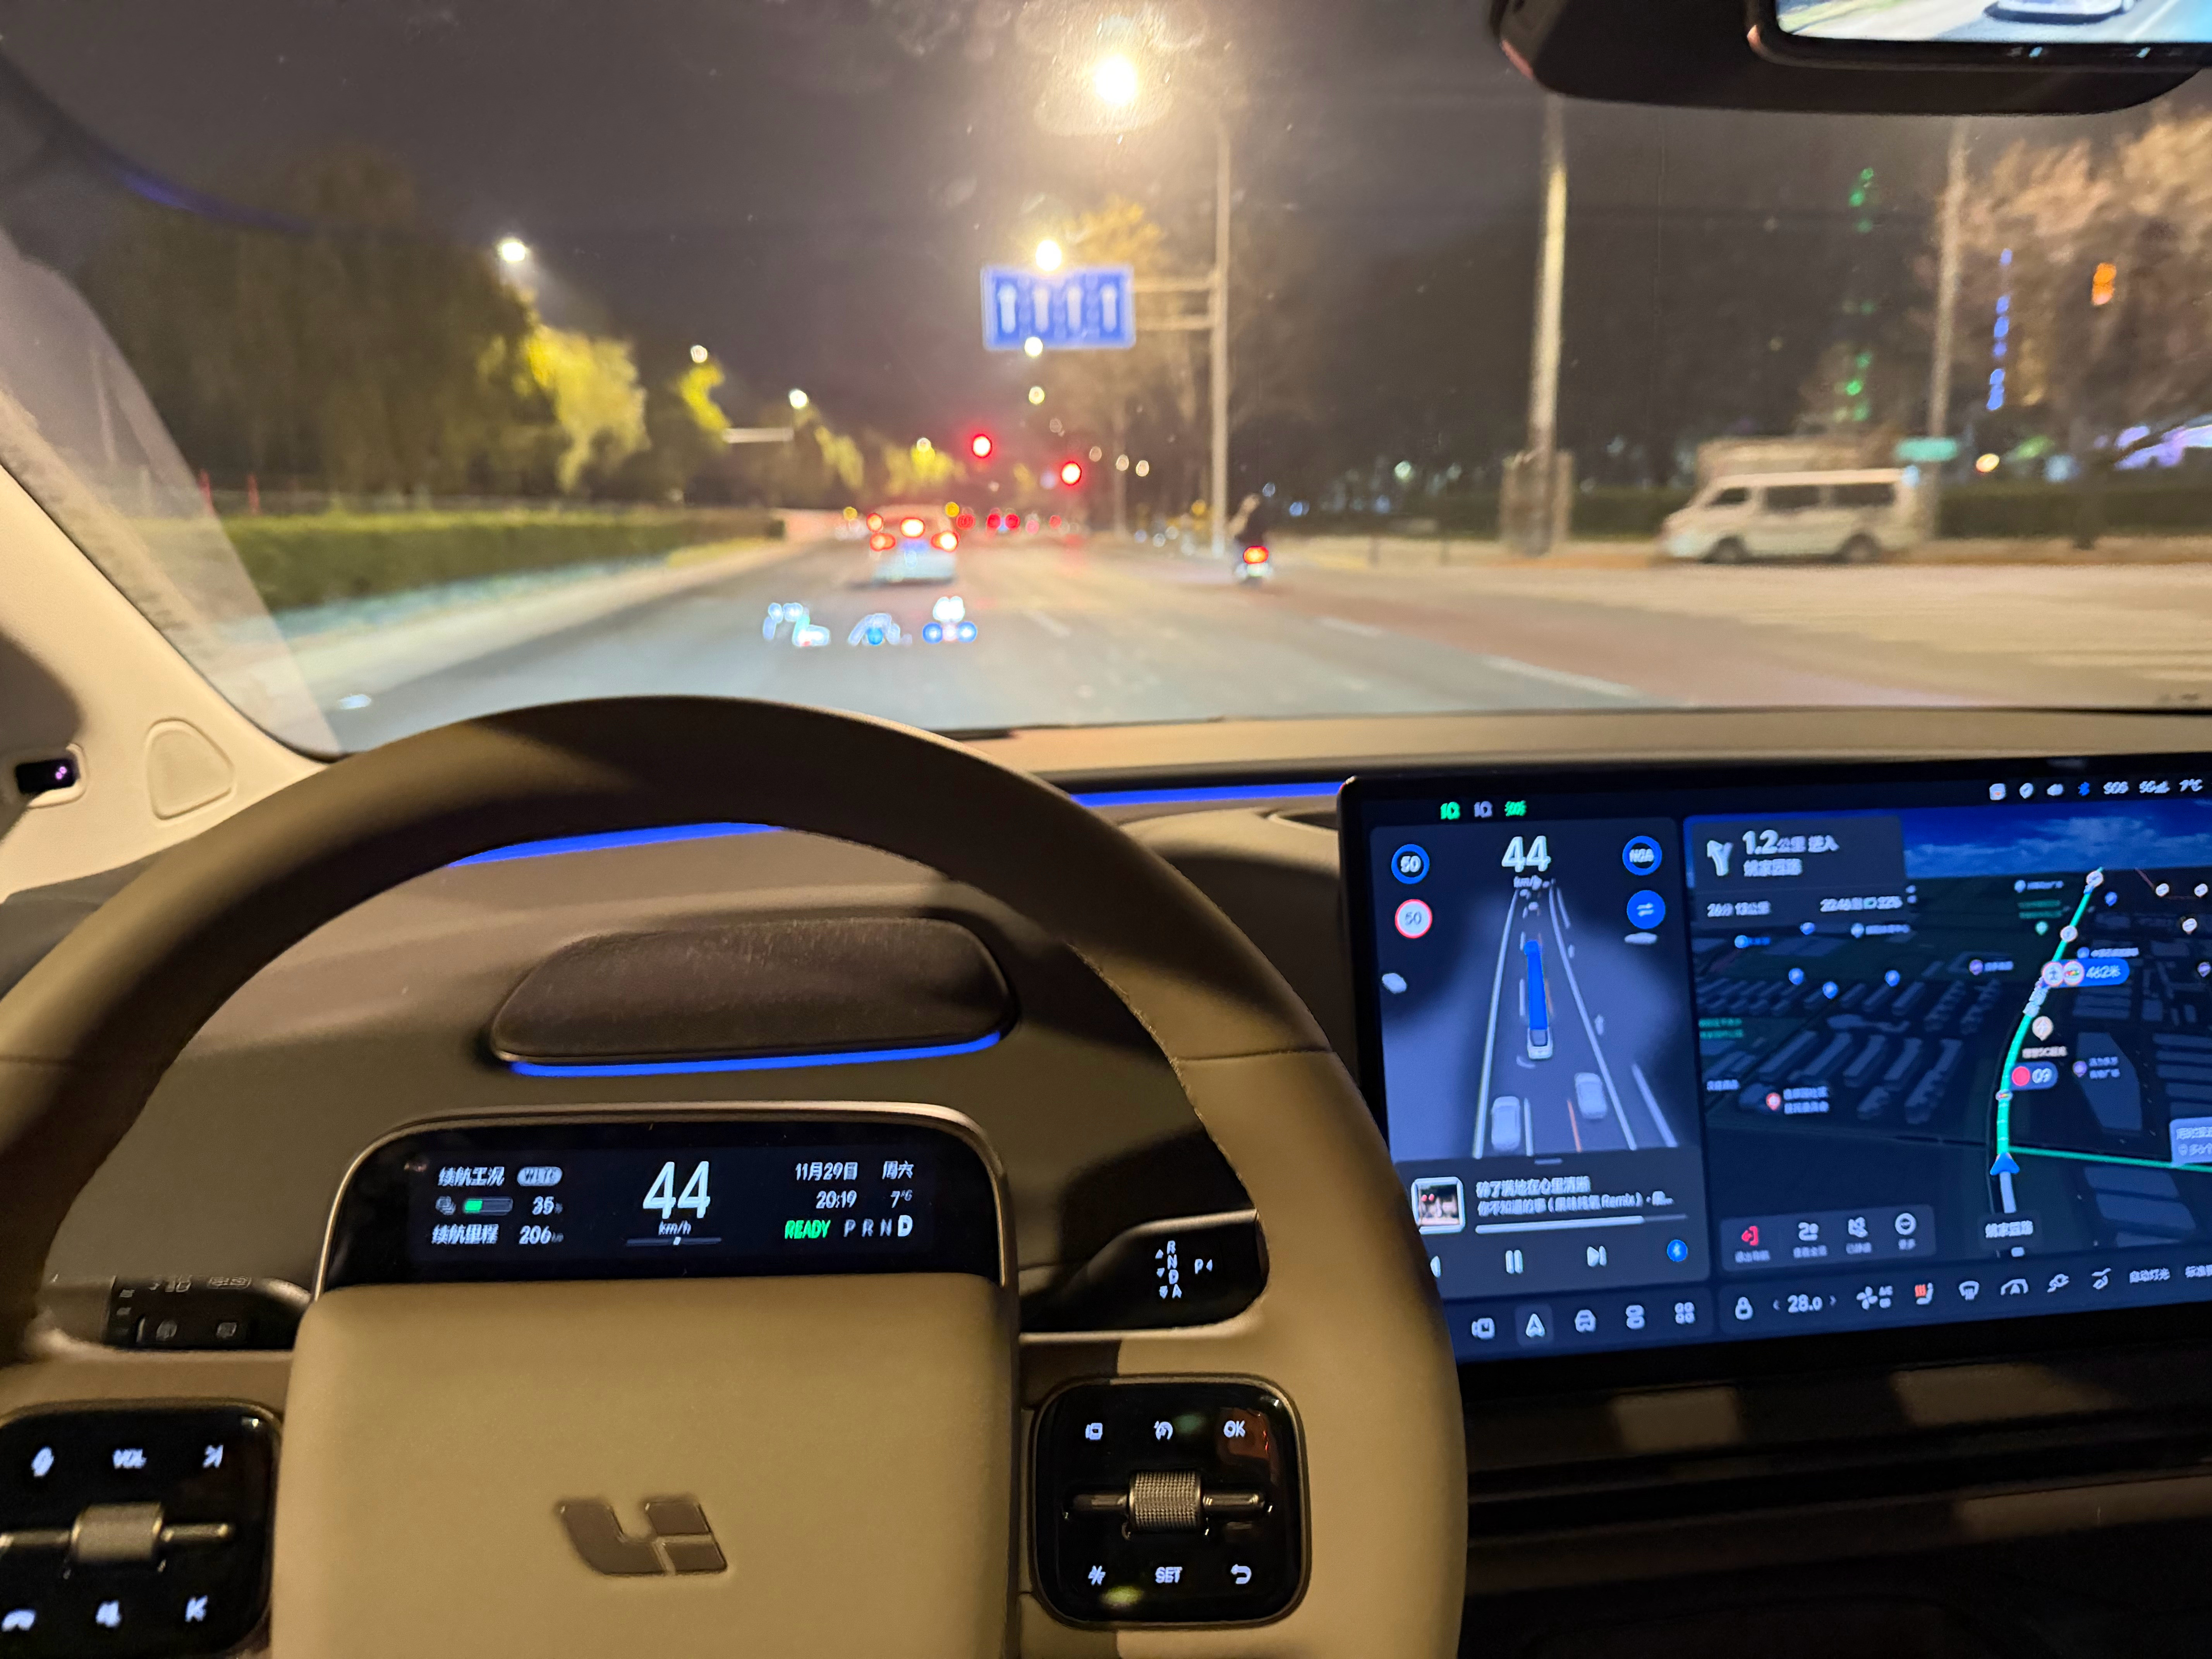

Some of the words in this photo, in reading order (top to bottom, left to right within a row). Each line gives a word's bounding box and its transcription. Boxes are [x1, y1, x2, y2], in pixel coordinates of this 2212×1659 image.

[1501, 835, 1551, 872] 44
[795, 1161, 858, 1181] 11月29日
[643, 1161, 711, 1219] 44
[816, 1190, 857, 1209] 20:19
[658, 1220, 692, 1235] km/h
[784, 1219, 831, 1239] READY
[843, 1219, 857, 1237] P
[861, 1218, 874, 1238] R
[879, 1218, 892, 1237] N
[897, 1214, 913, 1237] D
[1166, 1240, 1176, 1254] R
[1167, 1254, 1178, 1269] N
[1195, 1258, 1204, 1274] P
[1168, 1269, 1179, 1285] D
[1172, 1283, 1182, 1298] A
[1788, 1294, 1823, 1313] 28.0
[1223, 1420, 1246, 1438] OK
[1155, 1566, 1183, 1584] SET
